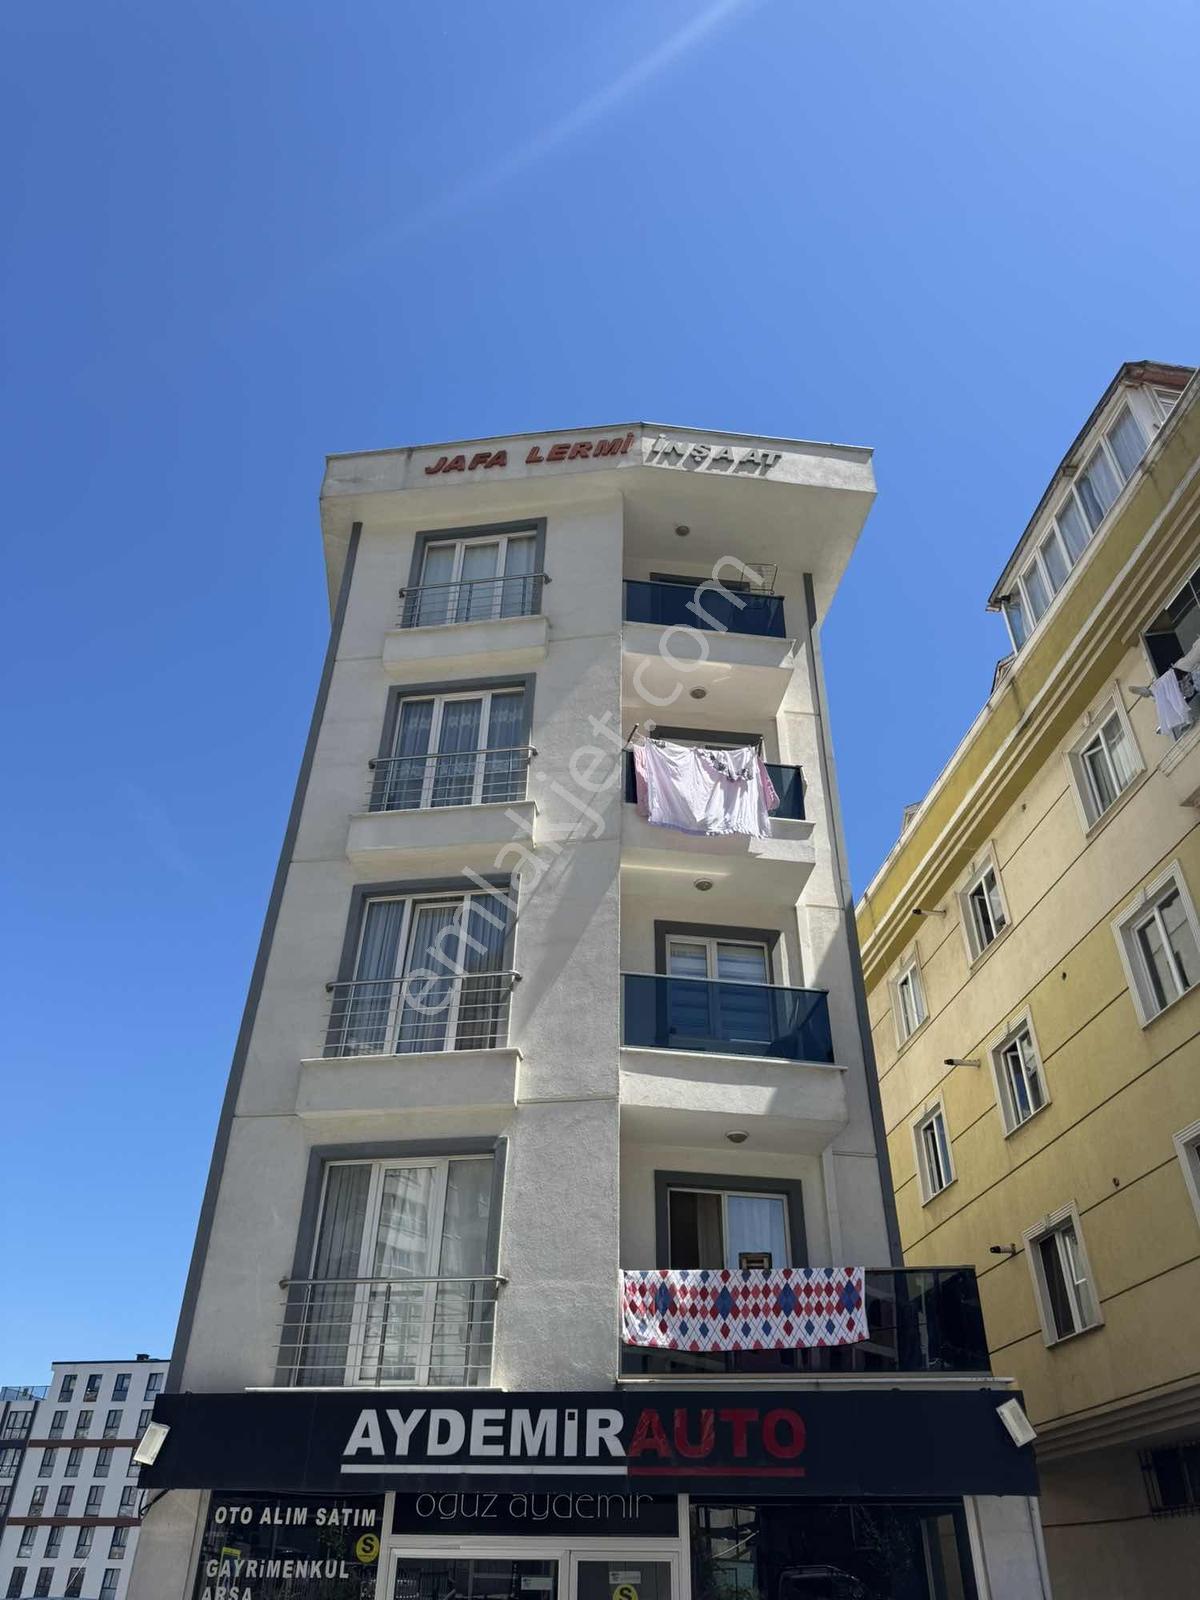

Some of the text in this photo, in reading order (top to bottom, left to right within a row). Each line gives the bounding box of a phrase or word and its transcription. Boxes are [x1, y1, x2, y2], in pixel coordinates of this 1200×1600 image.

[425, 431, 782, 475] JAFA LERMİ İNŞAAT
[628, 1408, 807, 1458] AUTO
[215, 1506, 376, 1527] OTO ALIM SATIM
